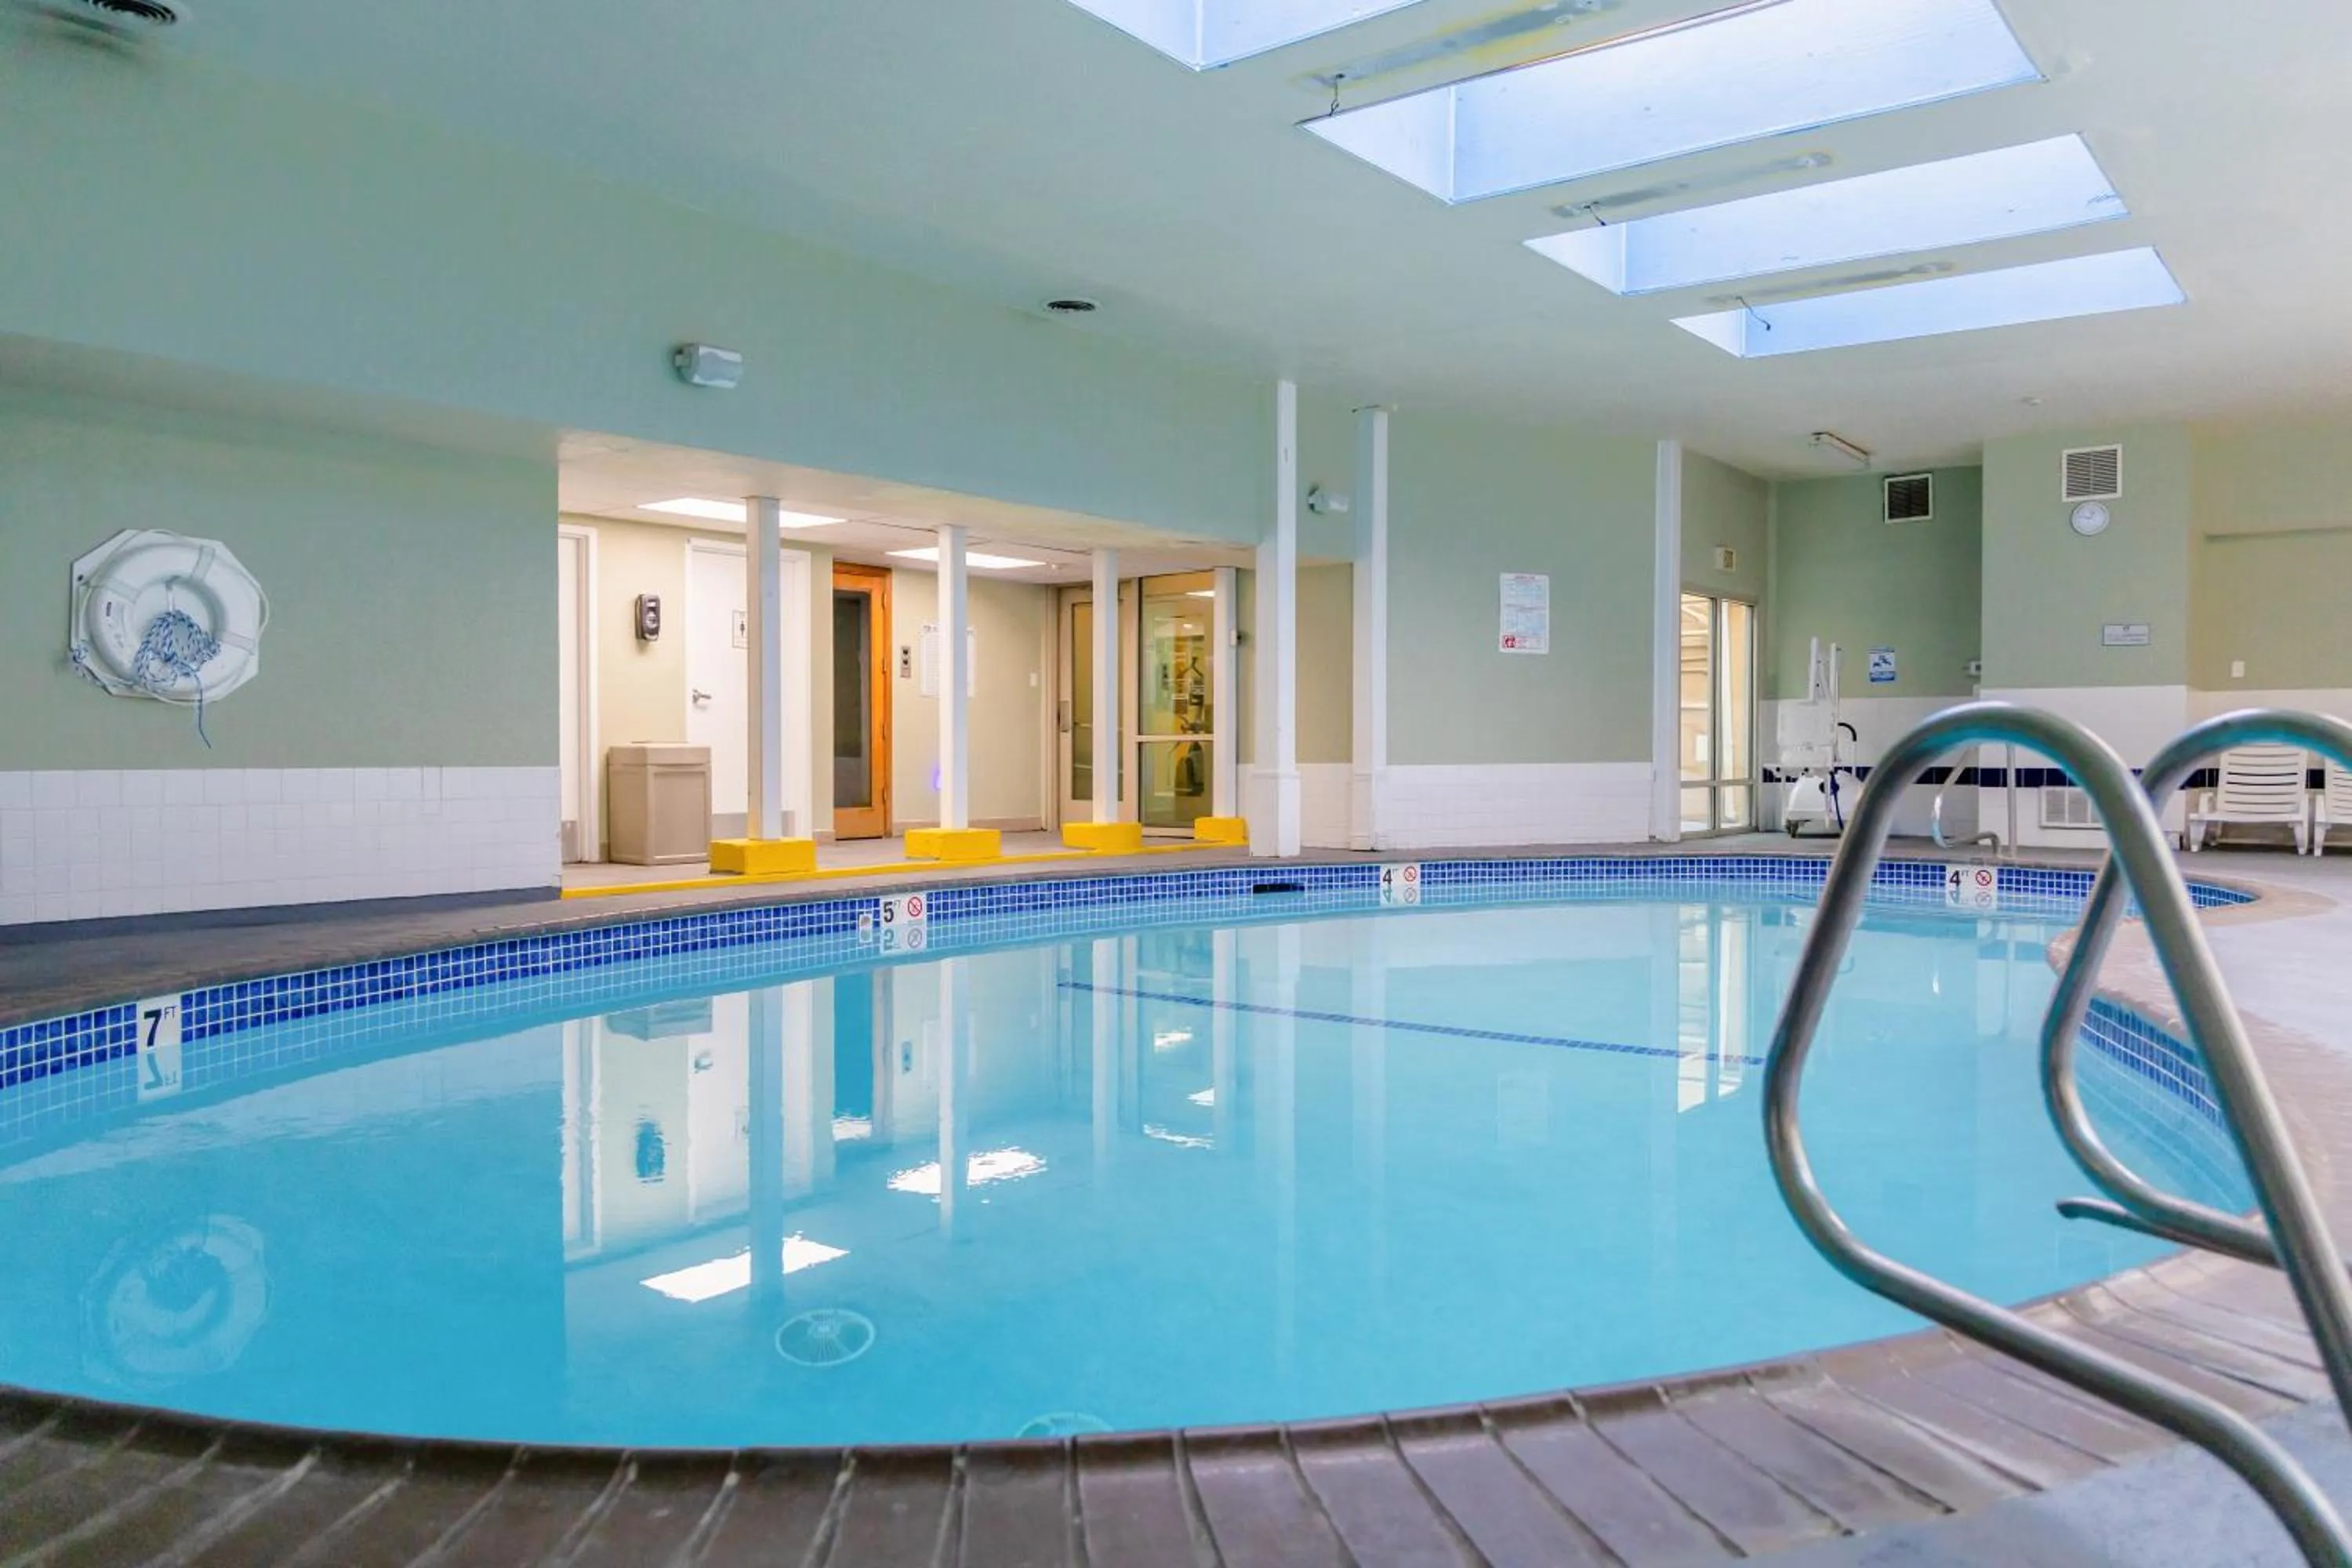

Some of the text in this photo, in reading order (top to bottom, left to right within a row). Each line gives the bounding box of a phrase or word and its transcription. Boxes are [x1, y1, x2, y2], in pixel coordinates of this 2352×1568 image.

[1383, 869, 1392, 884] 4
[1949, 870, 1961, 886] 4
[884, 901, 895, 923] 5
[144, 1006, 177, 1047] 7 FT
